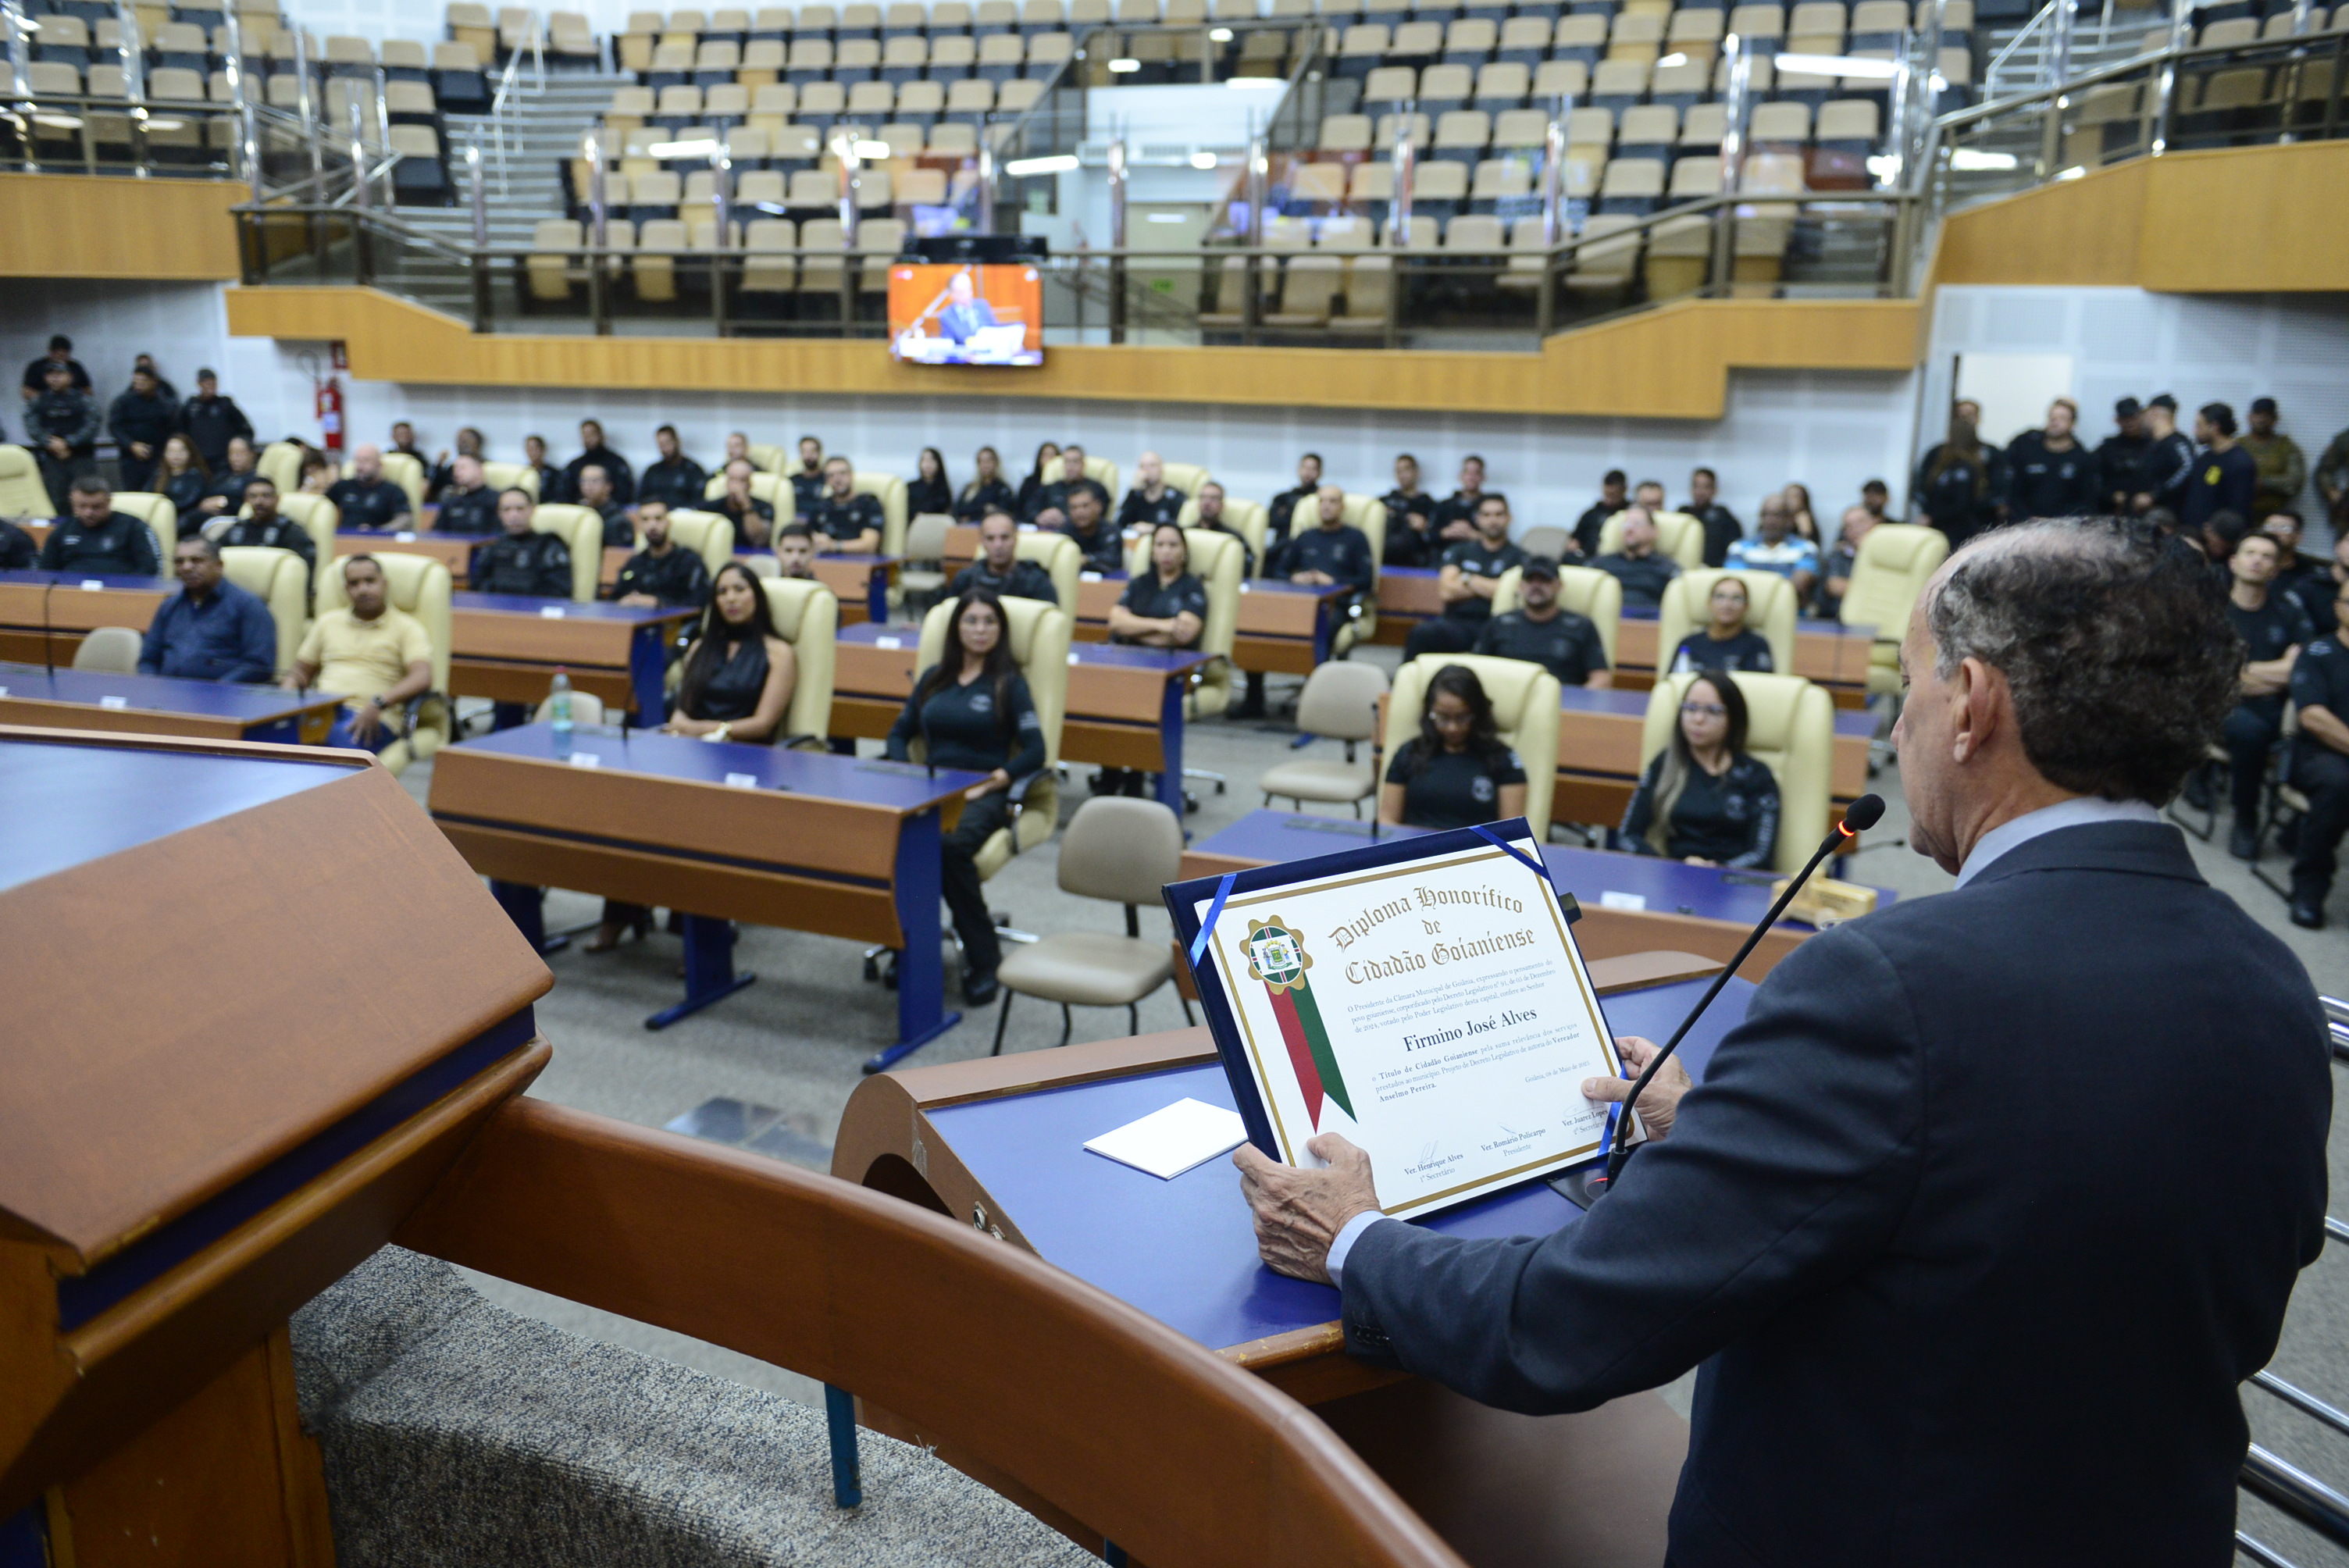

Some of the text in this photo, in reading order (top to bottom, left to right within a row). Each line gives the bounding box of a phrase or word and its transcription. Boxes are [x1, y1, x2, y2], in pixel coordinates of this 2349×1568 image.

[1327, 884, 1523, 953] Diploma Honorífico
[1420, 918, 1443, 935] de
[1345, 949, 1427, 985] Cidadão
[1350, 1015, 1366, 1025] povo
[1365, 1008, 1397, 1022] goianiense,
[1395, 998, 1431, 1013] corporificado
[1431, 994, 1444, 1007] pelo
[1442, 991, 1465, 1001] Decreto
[1463, 983, 1494, 996] Legislativo
[1528, 969, 1556, 980] Dezembro
[1353, 1000, 1385, 1012] Presidente
[1392, 992, 1417, 1002] Câmara
[1414, 983, 1445, 997] Municipal
[1451, 977, 1476, 988] Goiânia,
[1475, 969, 1509, 983] expressando
[1513, 962, 1545, 976] pensamento
[1353, 1023, 1363, 1034] de
[1379, 1016, 1400, 1027] votado
[1400, 1011, 1414, 1025] pelo
[1413, 1007, 1431, 1019] Poder
[1431, 1001, 1463, 1014] Legislativo
[1463, 998, 1480, 1007] desta
[1479, 991, 1500, 1003] capital,
[1499, 988, 1520, 998] confere
[1525, 982, 1545, 991] Senhor
[1401, 1009, 1538, 1053] Firmino José Alves
[1378, 1068, 1402, 1080] Título
[1403, 1065, 1414, 1074] de
[1414, 1058, 1442, 1071] Cidadão
[1443, 1049, 1479, 1063] Goianiense
[1480, 1044, 1494, 1056] pela
[1495, 1040, 1511, 1049] suma
[1512, 1032, 1542, 1045] relevância
[1542, 1028, 1553, 1037] dos
[1554, 1023, 1577, 1033] serviços
[1374, 1079, 1406, 1095] prestados
[1412, 1068, 1442, 1083] município.
[1440, 1064, 1463, 1074] Projeto
[1461, 1060, 1470, 1069] de
[1468, 1056, 1492, 1067] Decreto
[1490, 1048, 1520, 1061] Legislativo
[1520, 1045, 1527, 1053] de
[1527, 1041, 1546, 1051] autoria
[1551, 1032, 1580, 1044] Vereador
[1558, 1065, 1572, 1074] Maio
[1379, 1081, 1438, 1103] Anselmo Pereira.
[1573, 1114, 1592, 1124] Juarez
[1590, 1108, 1610, 1121] Lopes
[1579, 1120, 1606, 1134] Secretário
[1492, 1135, 1519, 1149] Romário
[1517, 1128, 1546, 1142] Policarpo
[1502, 1143, 1532, 1157] Presidente
[1417, 1158, 1447, 1174] Henrique
[1446, 1153, 1464, 1164] Alves
[1425, 1166, 1456, 1181] Secretário
